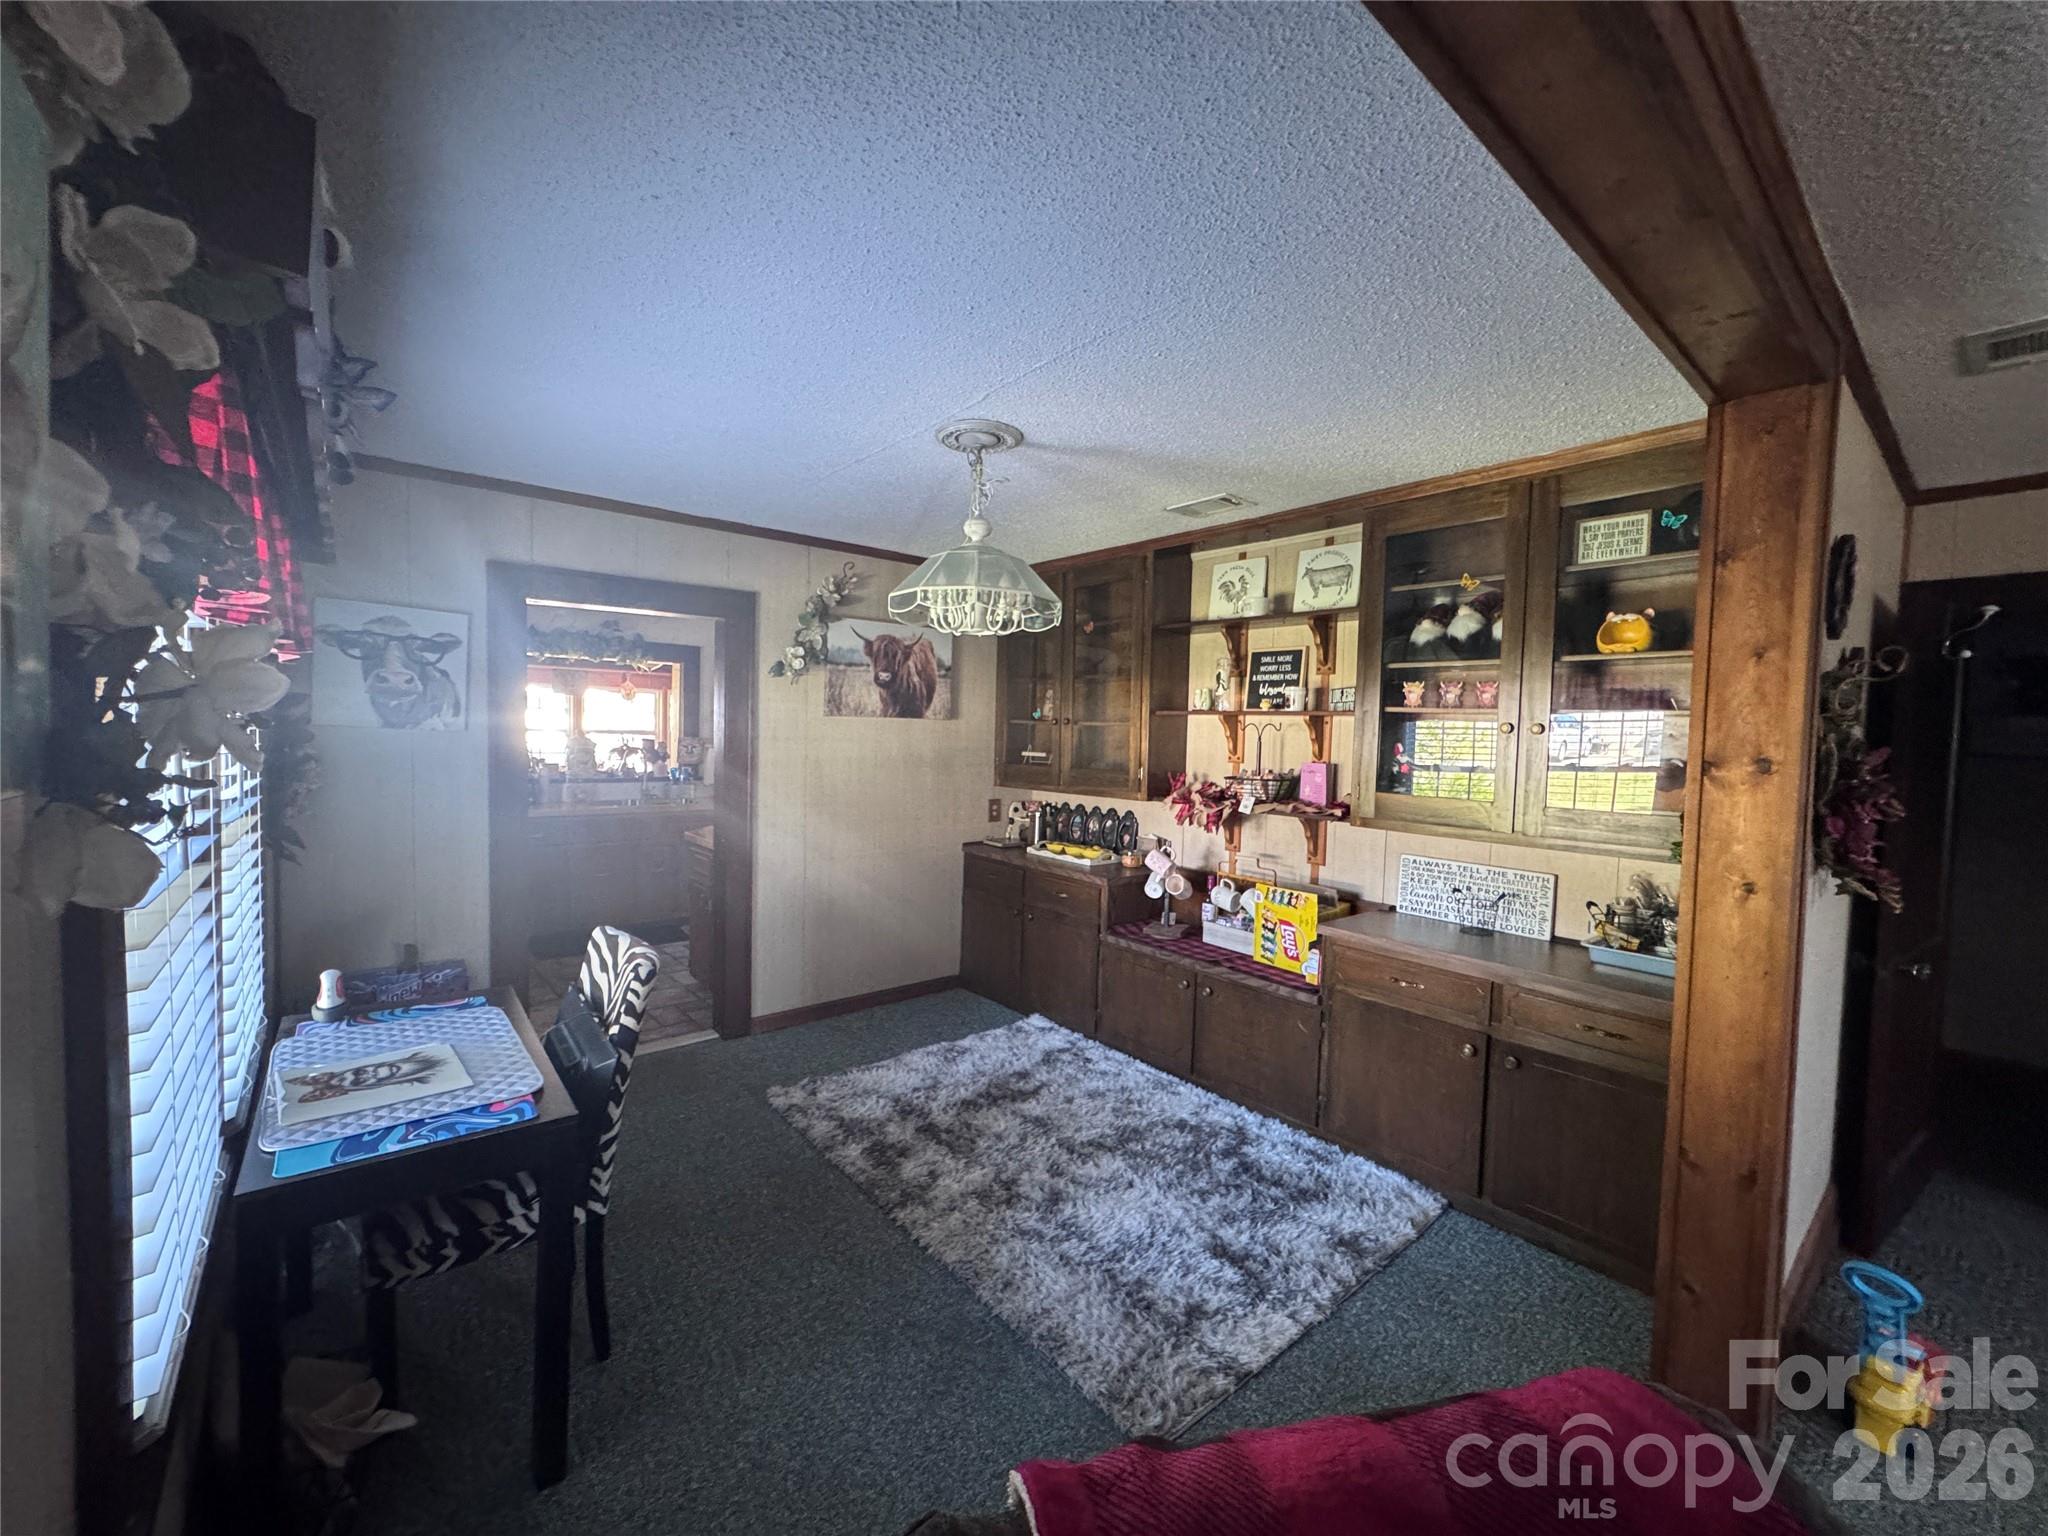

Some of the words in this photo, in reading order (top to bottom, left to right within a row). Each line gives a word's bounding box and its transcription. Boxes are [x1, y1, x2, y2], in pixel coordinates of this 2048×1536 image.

[1583, 524, 1601, 534] WASH
[1603, 521, 1619, 531] YOUR
[1623, 519, 1644, 528] HANDS
[1589, 533, 1599, 541] SAY
[1602, 531, 1615, 540] YOUR
[1618, 528, 1643, 538] PRAYERS
[1597, 540, 1614, 549] JESUS
[1623, 537, 1643, 546] GERMS
[1582, 552, 1594, 560] ARE
[1597, 546, 1642, 559] EVERYWHERE
[1261, 655, 1276, 663] SMILE
[1412, 859, 1452, 870] ALWAYS
[1457, 865, 1482, 874] TELL
[1488, 870, 1509, 878] THE
[1514, 873, 1550, 884] TRUTH
[1410, 877, 1438, 886] KEEP
[1443, 882, 1472, 892] YOUR
[1478, 887, 1538, 903] PROMISES
[1501, 879, 1539, 890] GRATEFUL
[1472, 900, 1499, 912] LOUD
[1502, 906, 1537, 919] THINGS
[1503, 899, 1517, 907] TRY
[1519, 901, 1537, 910] NEW
[1399, 905, 1450, 919] REMEMBER
[1454, 915, 1473, 924] YOU
[1477, 919, 1497, 928] ARE
[1500, 923, 1535, 936] LOVED
[1409, 899, 1424, 907] SAY
[1427, 902, 1462, 914] PLEASE
[1515, 918, 1537, 928] YOU
[1279, 924, 1298, 958] Lay's
